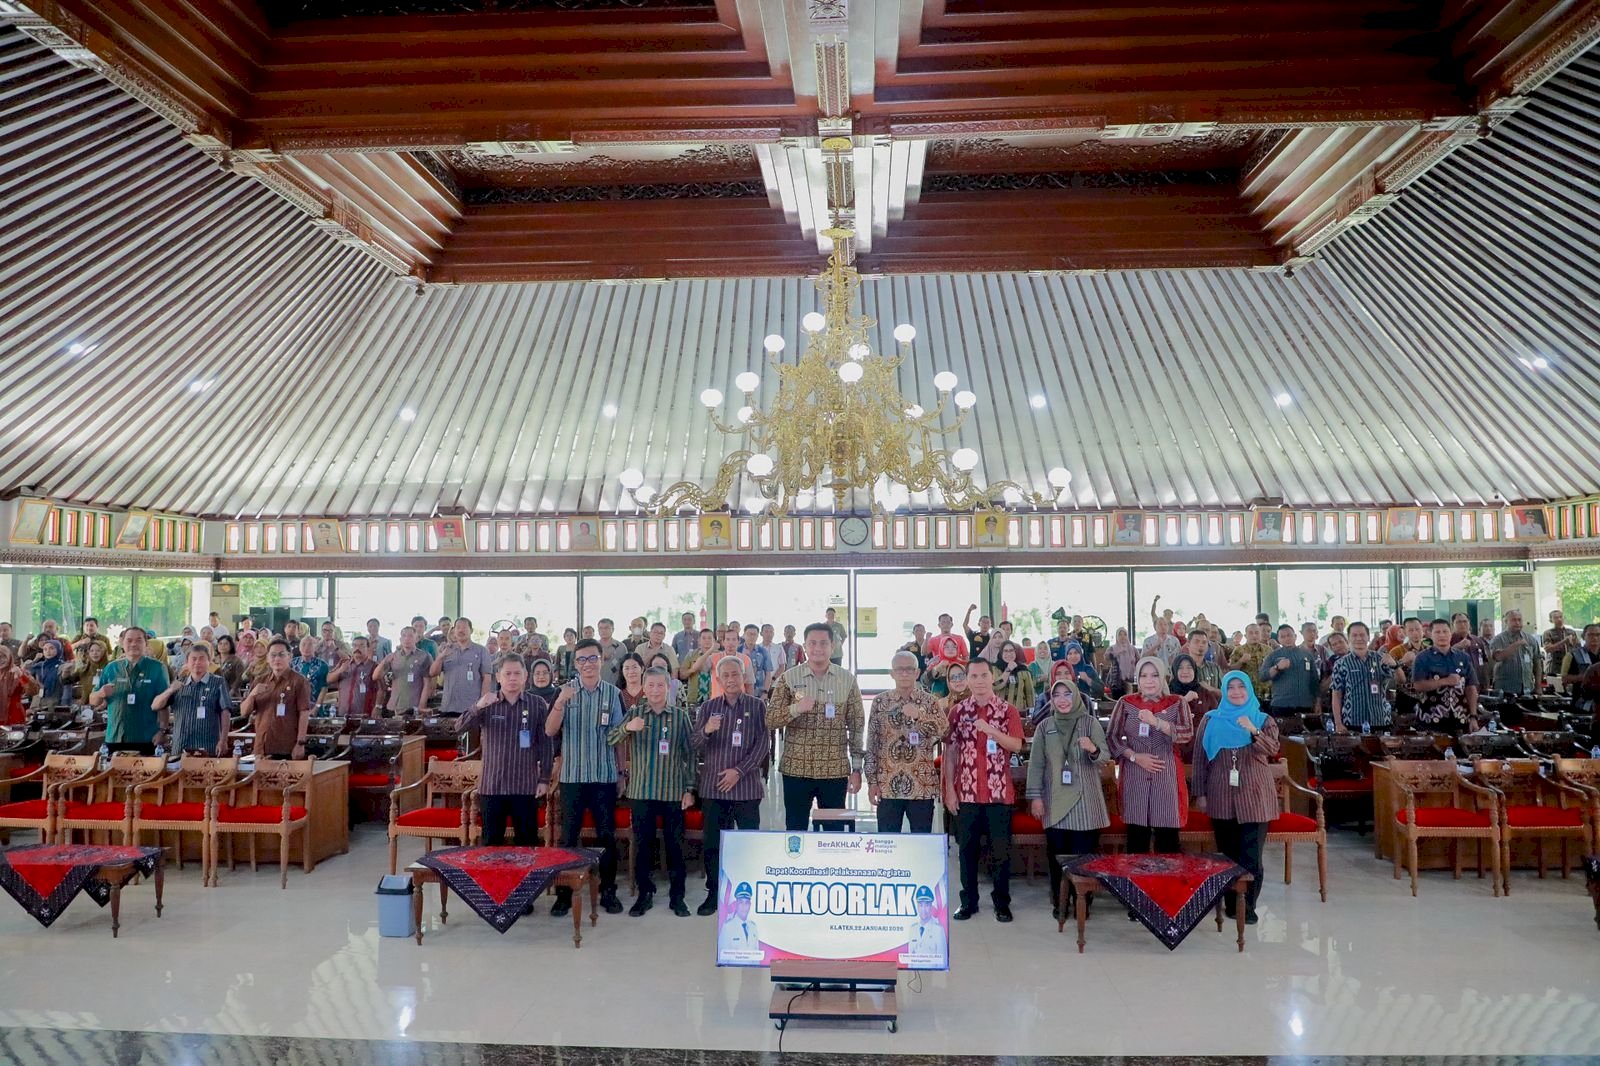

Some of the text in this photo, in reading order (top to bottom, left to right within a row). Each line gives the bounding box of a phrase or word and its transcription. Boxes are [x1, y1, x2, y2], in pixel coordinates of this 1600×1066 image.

[817, 840, 861, 849] BerAKHLAK
[766, 866, 911, 878] Rapat Koordinasi Pelaksanaan Kegiatan
[756, 881, 917, 916] RAKOORLAK
